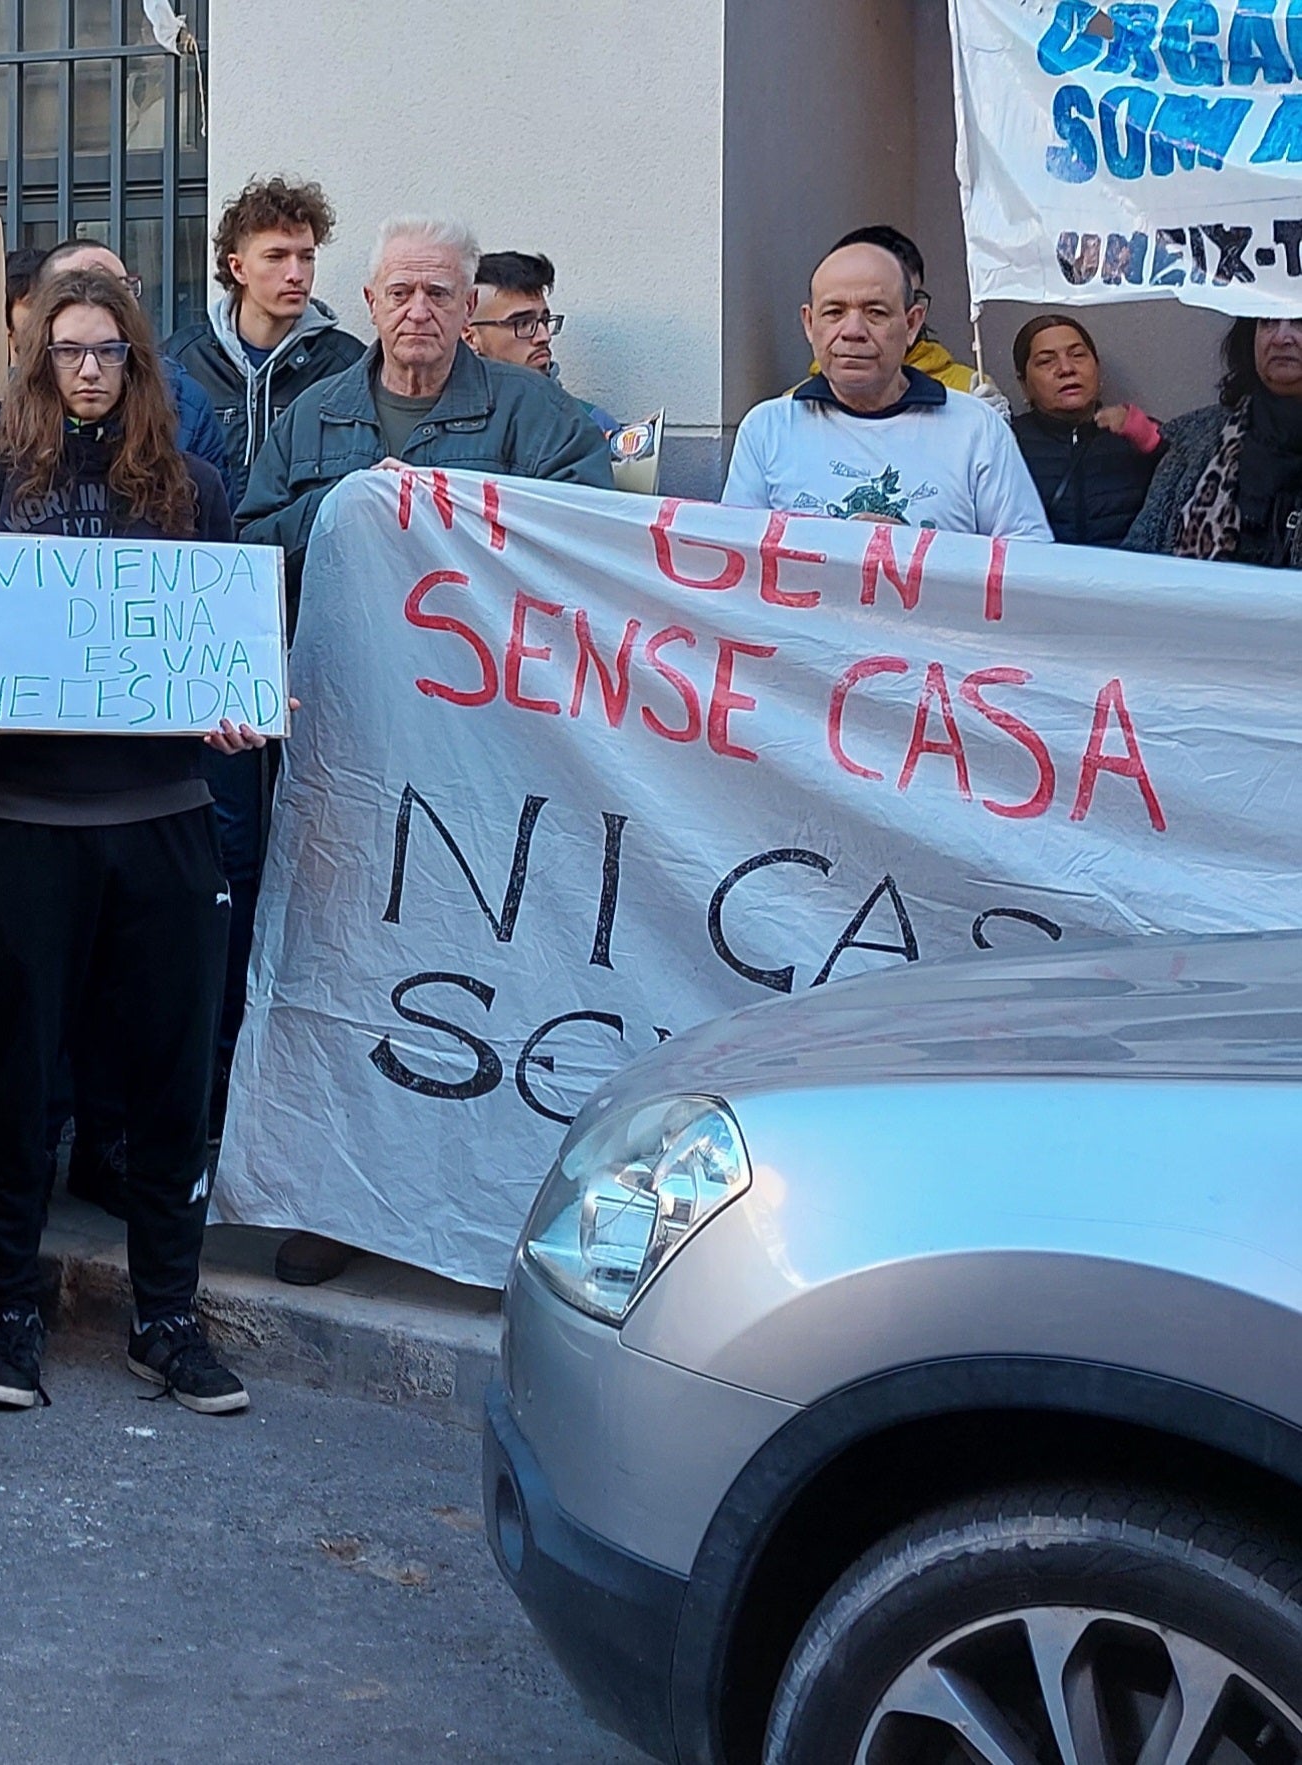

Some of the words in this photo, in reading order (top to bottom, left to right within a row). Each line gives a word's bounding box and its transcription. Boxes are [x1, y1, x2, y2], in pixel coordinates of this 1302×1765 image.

[1036, 0, 1302, 87] ORGA
[1046, 84, 1254, 183] SOM
[397, 470, 506, 552] NI
[68, 592, 216, 642] DIGNA
[85, 646, 138, 675] ES
[163, 640, 251, 677] UNA
[404, 569, 777, 762] SENSE
[827, 654, 1167, 832] CASA
[381, 781, 629, 970] NI
